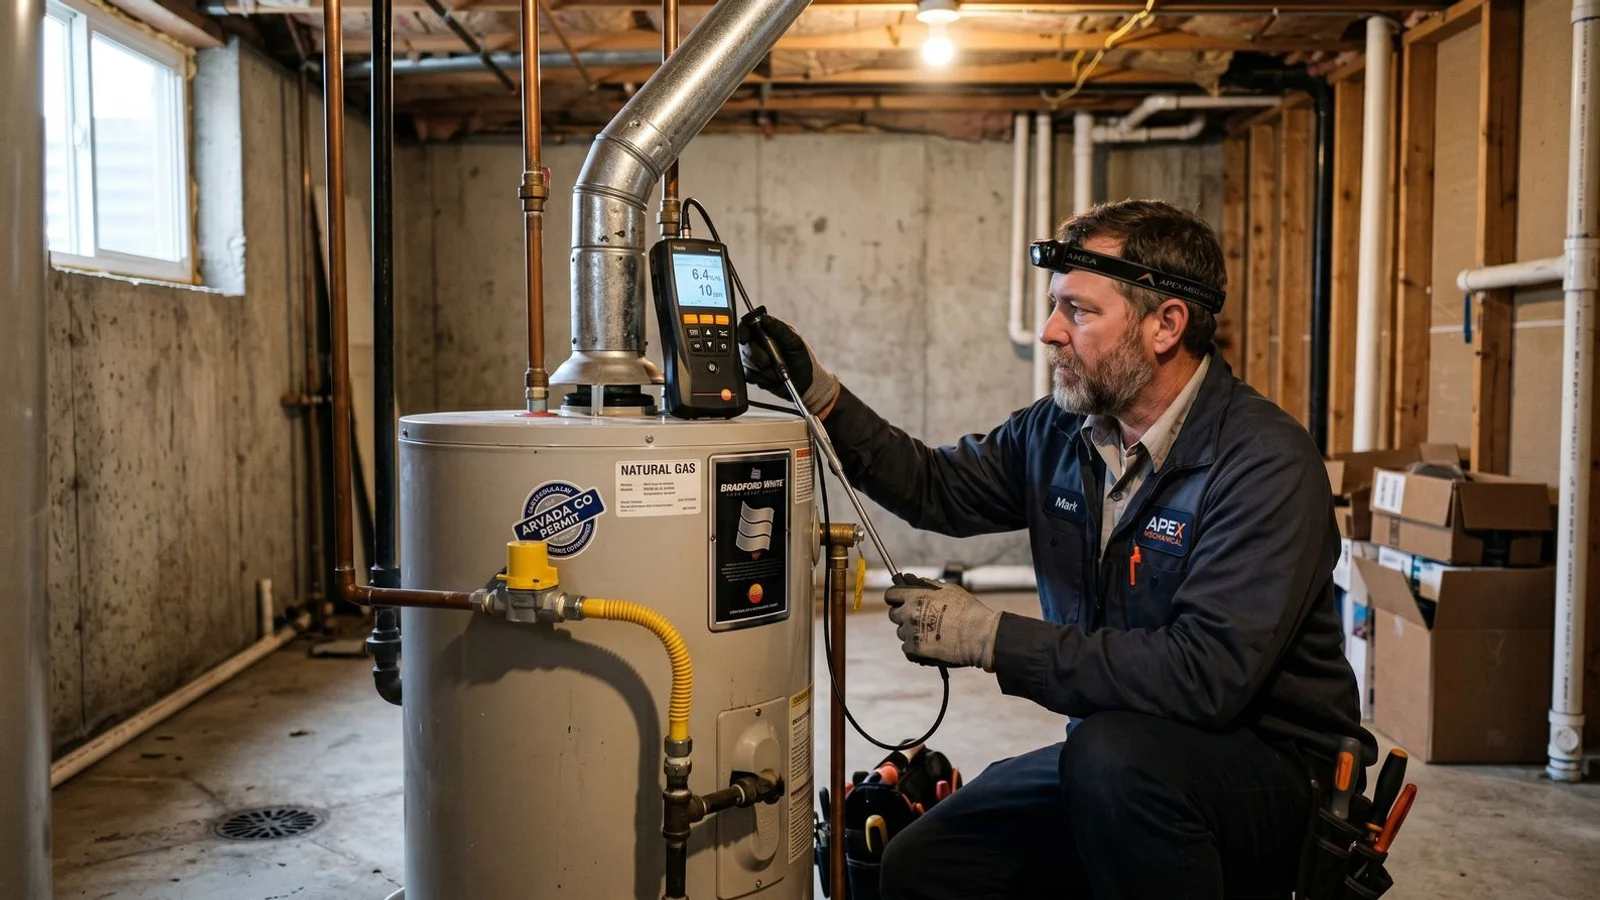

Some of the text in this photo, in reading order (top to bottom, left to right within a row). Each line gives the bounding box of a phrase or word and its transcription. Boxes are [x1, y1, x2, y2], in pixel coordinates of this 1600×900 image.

[692, 268, 709, 280] 6.4
[699, 284, 712, 296] 10
[621, 463, 696, 476] NATURAL GAS
[720, 479, 784, 492] BRADFORD WHITE
[1055, 496, 1078, 513] Mark
[522, 505, 572, 536] ARVADA
[574, 494, 593, 509] CO
[539, 512, 580, 538] PERMIT
[1146, 515, 1186, 538] APEX
[1143, 530, 1183, 547] MECHANICAL
